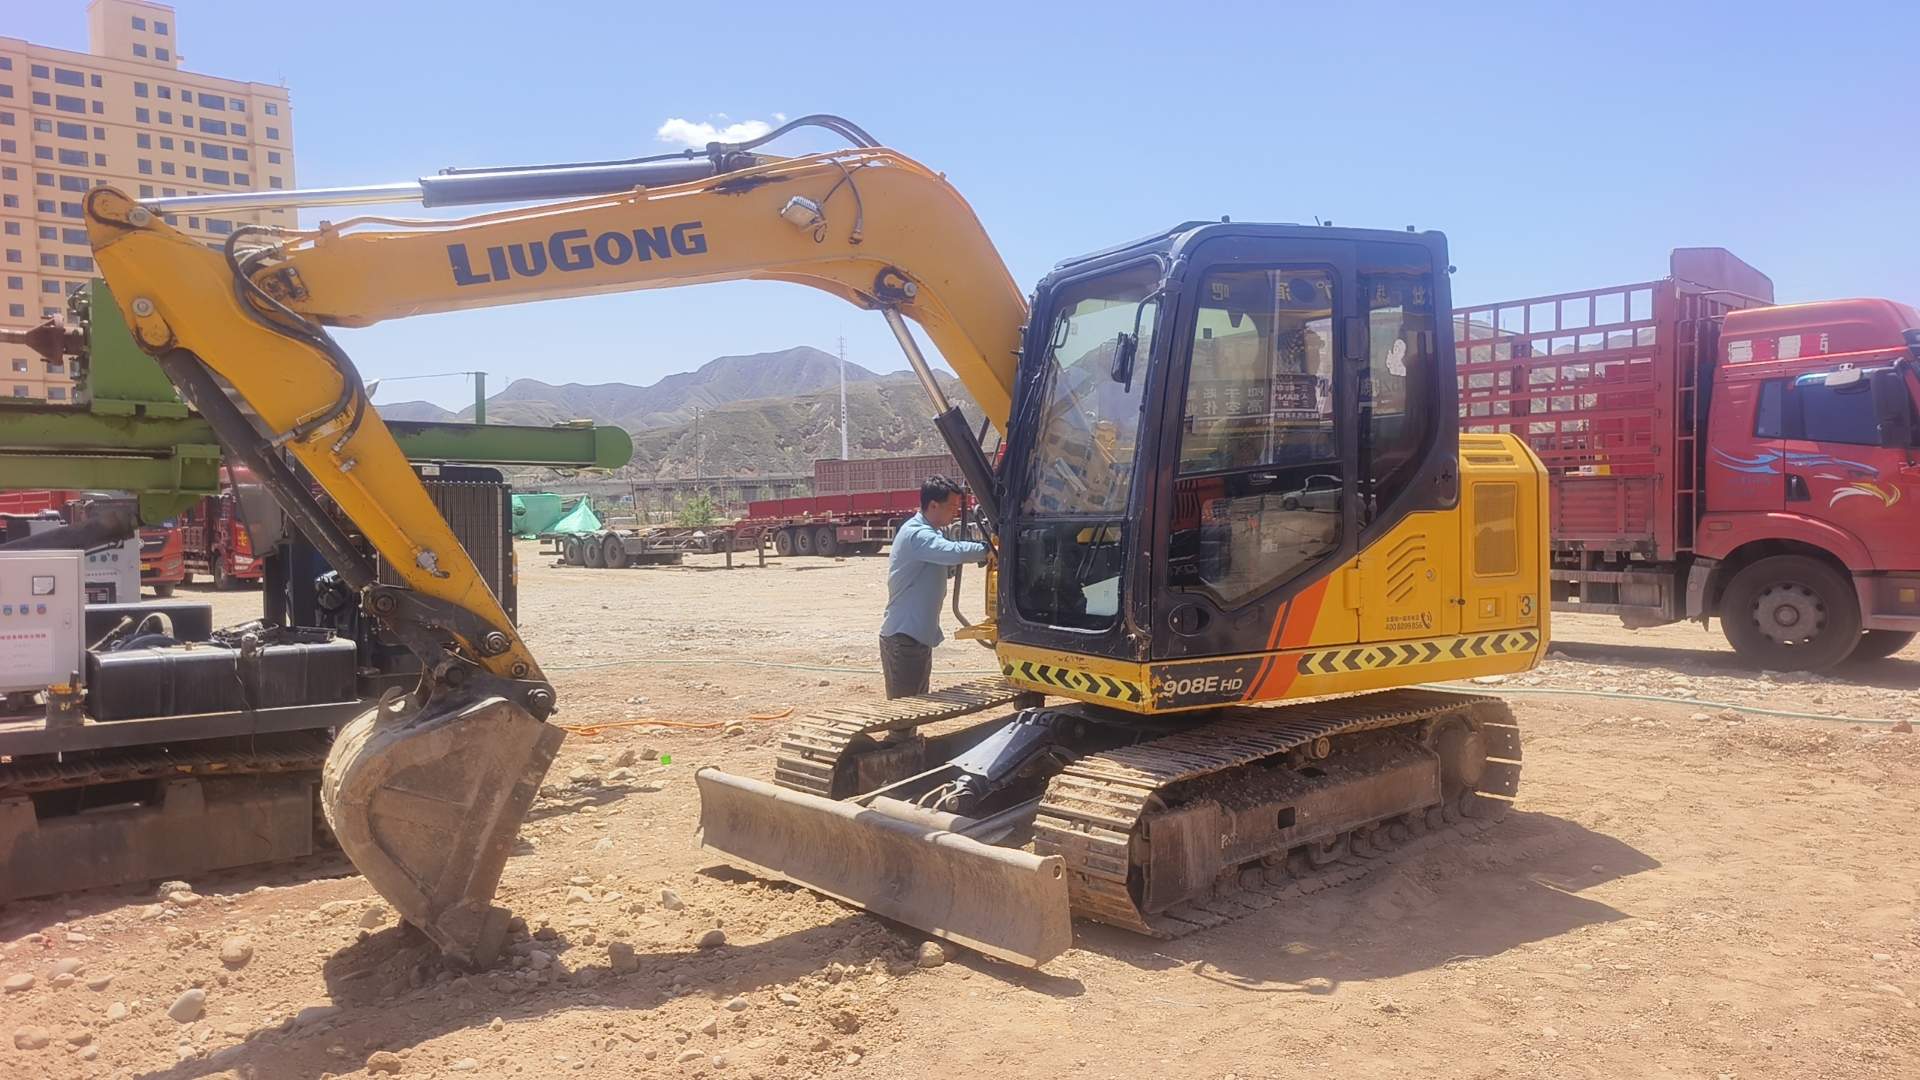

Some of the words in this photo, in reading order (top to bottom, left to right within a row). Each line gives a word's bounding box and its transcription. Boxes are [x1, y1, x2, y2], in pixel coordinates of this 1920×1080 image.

[447, 221, 708, 286] LIUGONG
[1520, 595, 1531, 616] 3
[1163, 676, 1219, 698] 908E
[1220, 678, 1243, 691] HD
